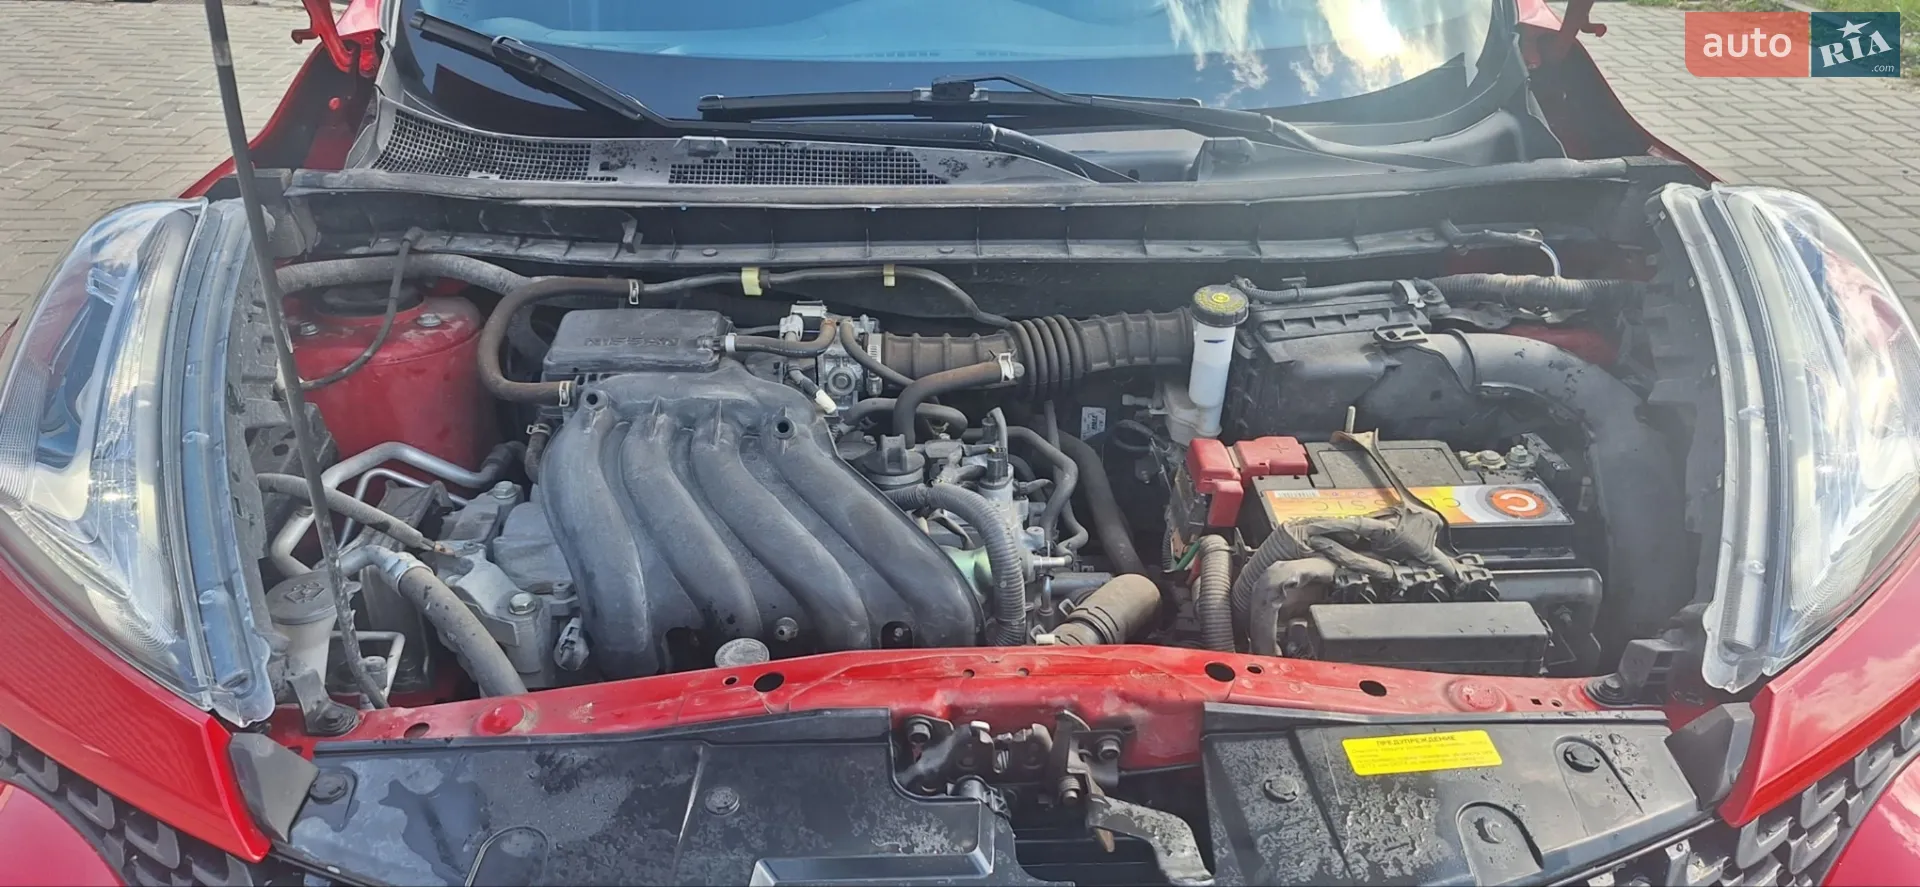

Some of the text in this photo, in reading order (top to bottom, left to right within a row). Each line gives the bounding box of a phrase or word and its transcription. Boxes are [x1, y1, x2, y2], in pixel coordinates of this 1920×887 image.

[584, 337, 681, 347] NISSAN
[1312, 498, 1461, 511] CLSSIC
[1376, 734, 1457, 747] ПРЕДУПРЕЖДЕНИЕ
